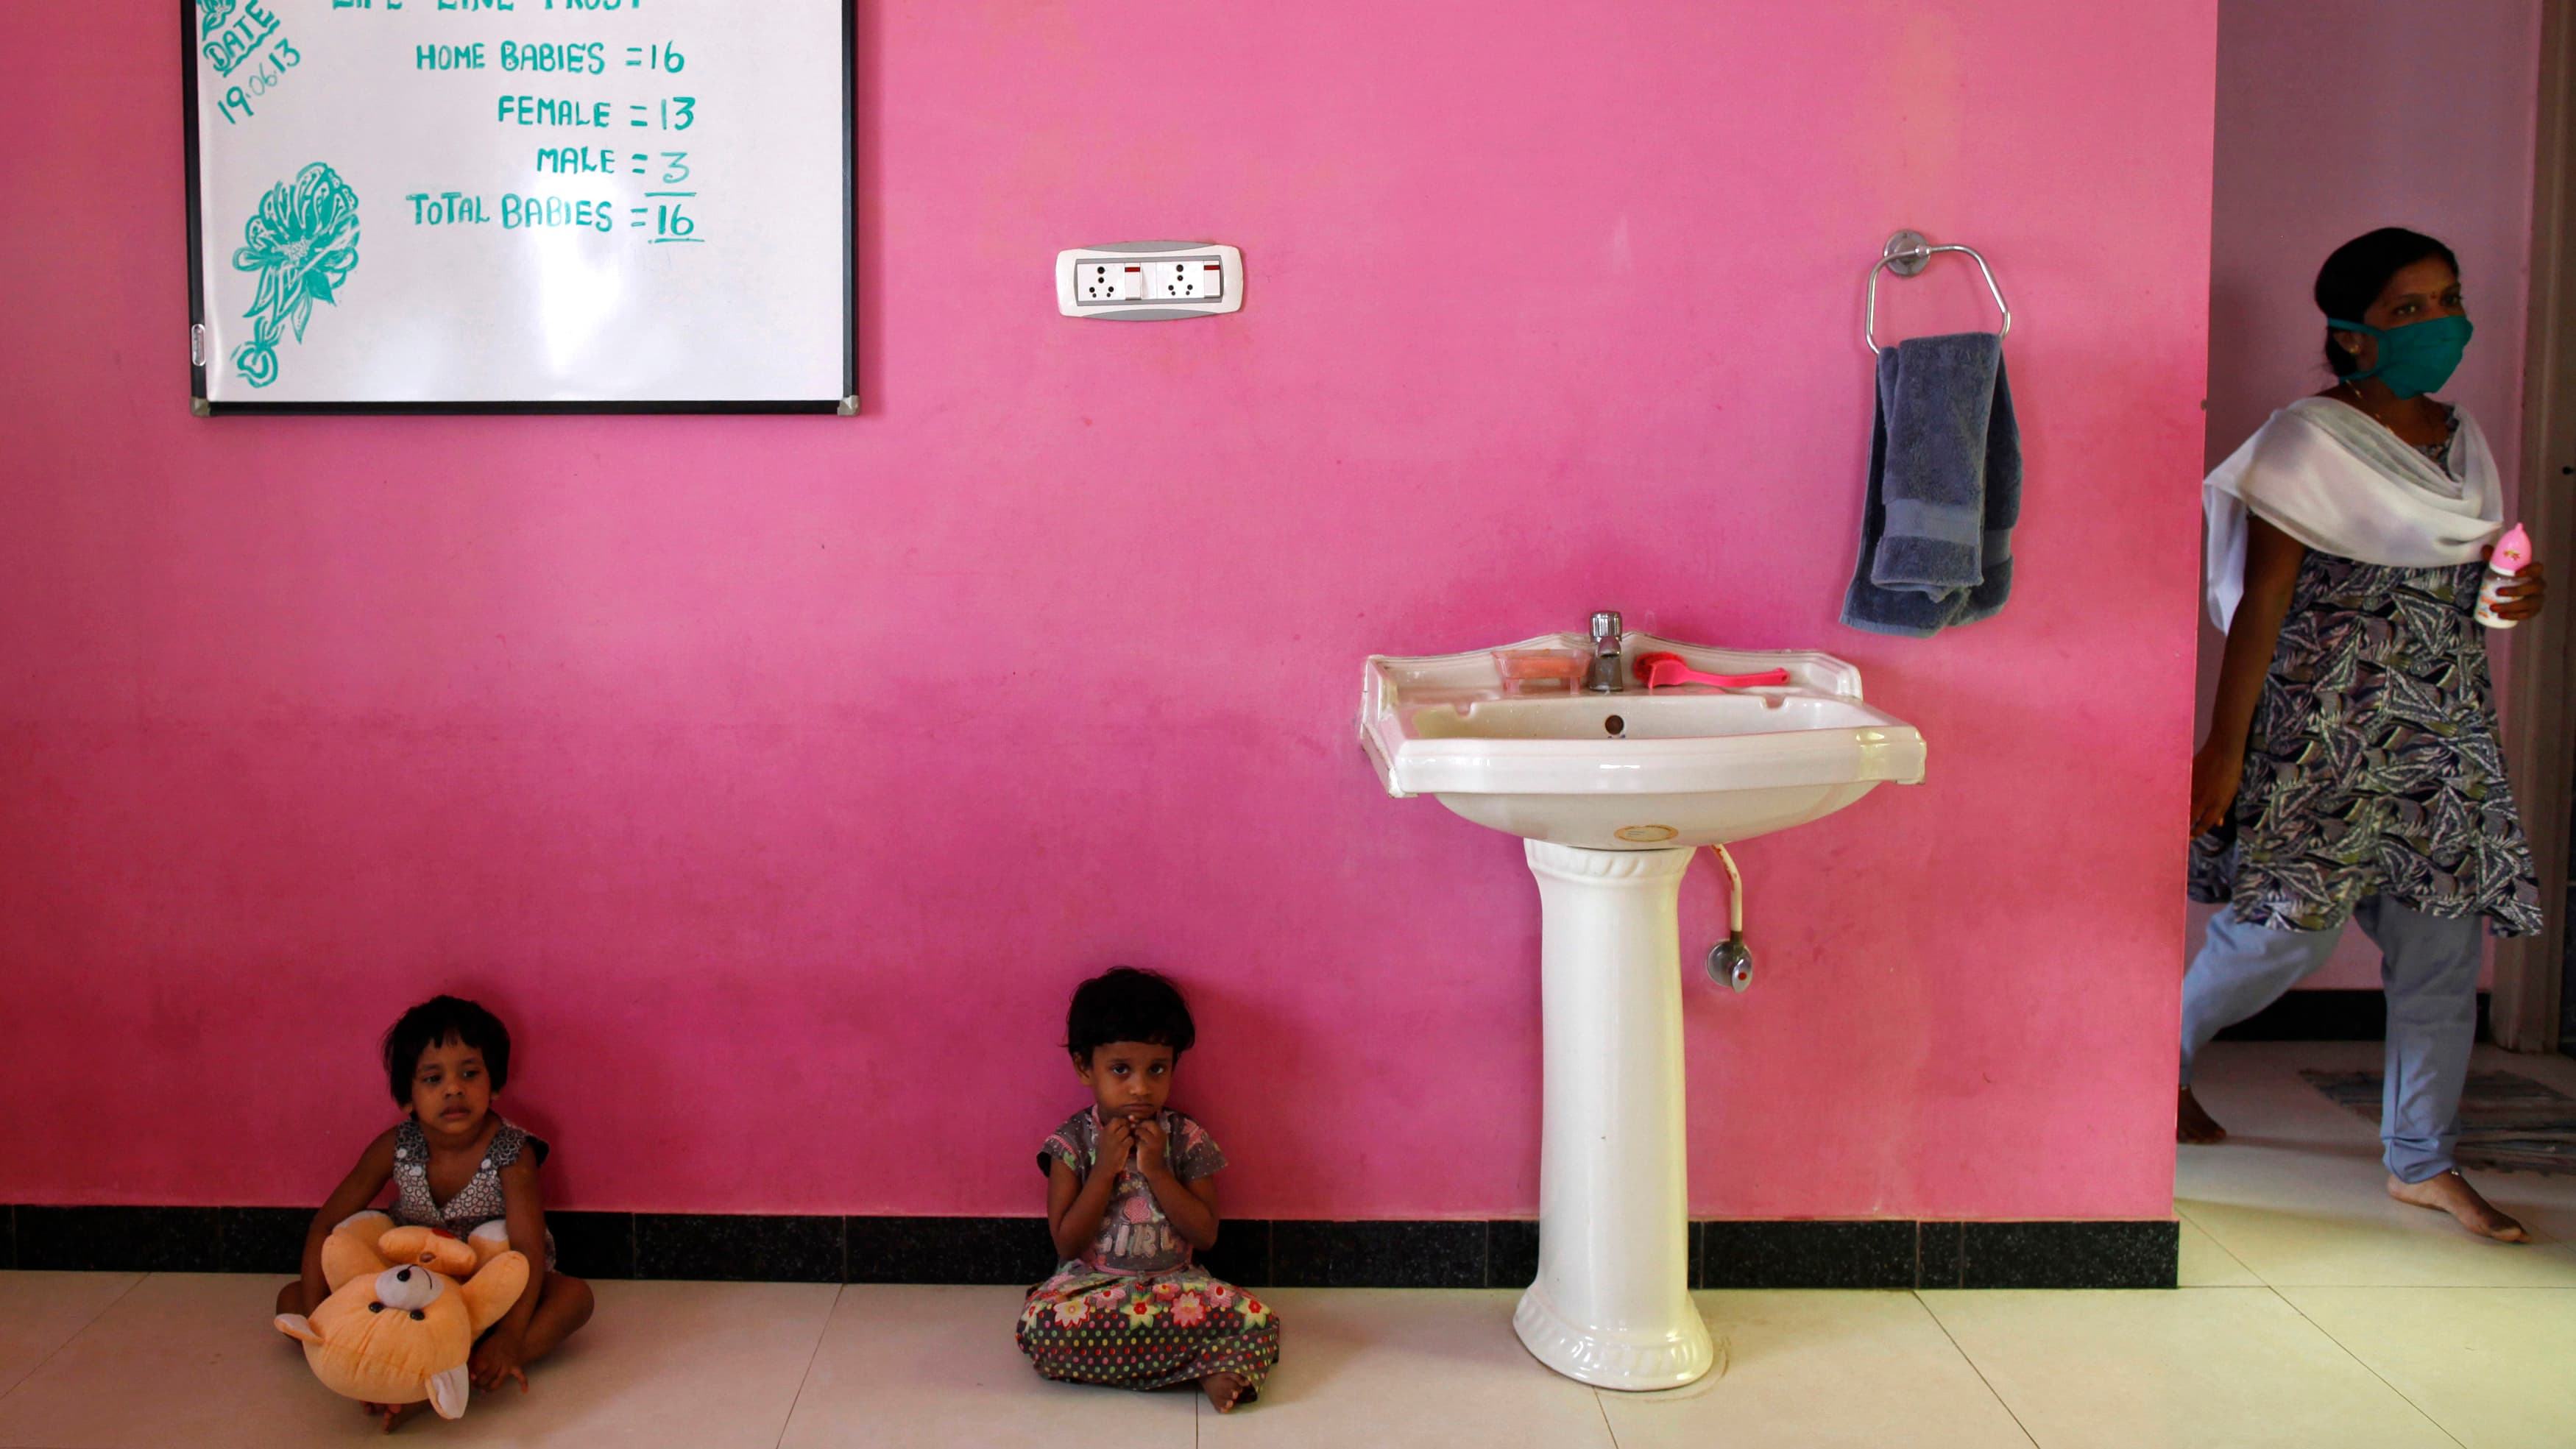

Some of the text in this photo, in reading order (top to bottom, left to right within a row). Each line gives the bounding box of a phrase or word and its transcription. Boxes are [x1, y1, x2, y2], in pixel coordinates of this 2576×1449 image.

[203, 0, 275, 71] DATE
[416, 42, 486, 70] HOME
[500, 40, 606, 75] BABIES
[498, 95, 611, 128] FEMALE
[537, 146, 615, 175] MALE
[406, 191, 491, 225] TOTAL
[501, 193, 612, 233] BABIES
